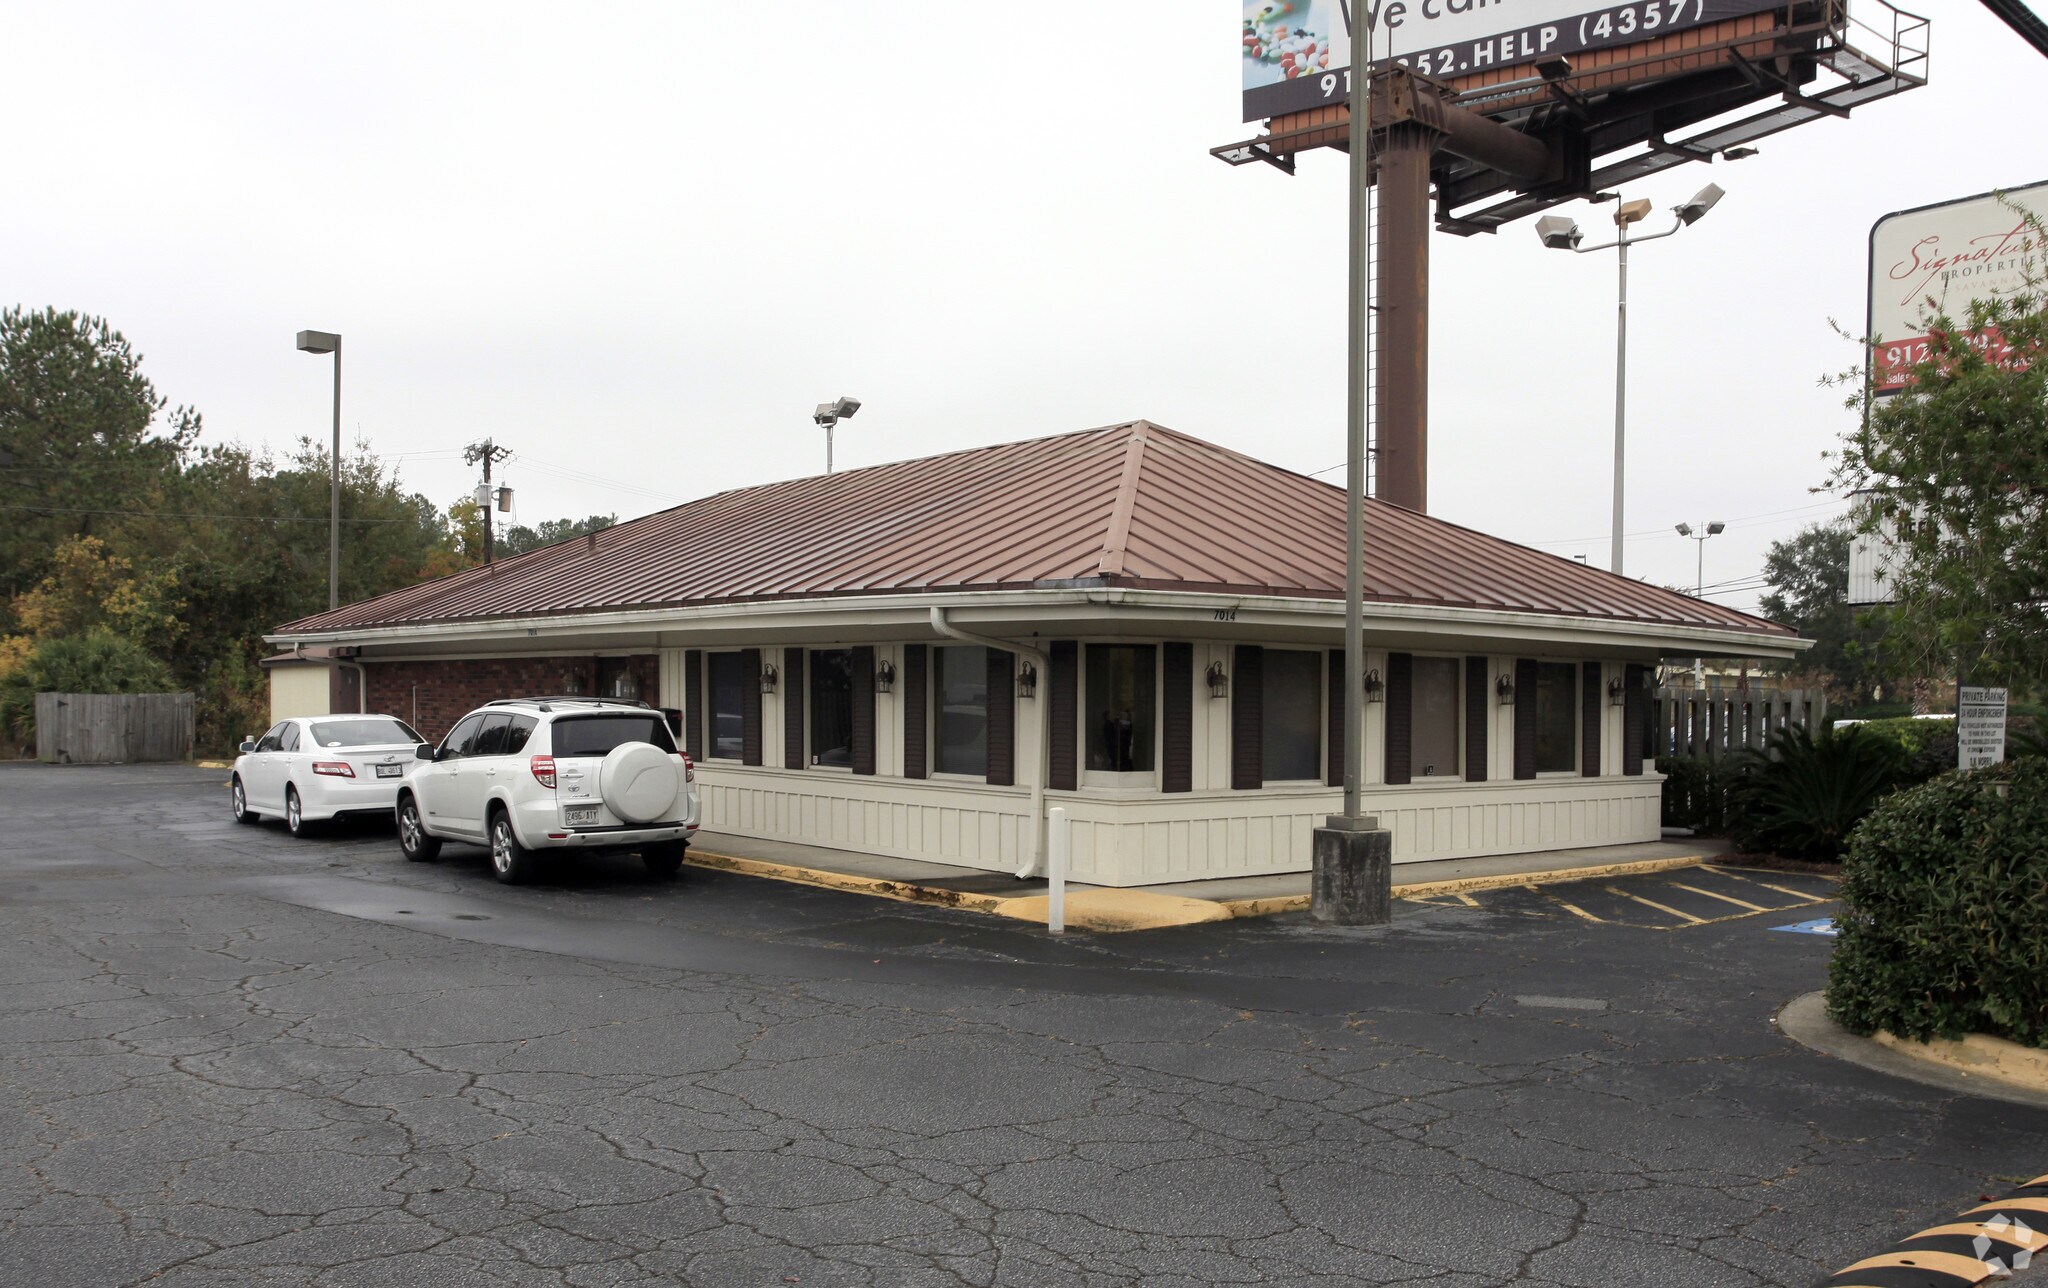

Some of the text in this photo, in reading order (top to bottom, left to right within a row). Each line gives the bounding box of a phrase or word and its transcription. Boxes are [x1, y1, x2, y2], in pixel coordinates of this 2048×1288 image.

[1579, 0, 1704, 47] (4357)
[1941, 254, 2047, 281] PROPERTIES
[1955, 273, 2031, 292] SAVANNA
[1213, 609, 1236, 621] 7014
[1962, 691, 2005, 702] PRIVATE PARKING
